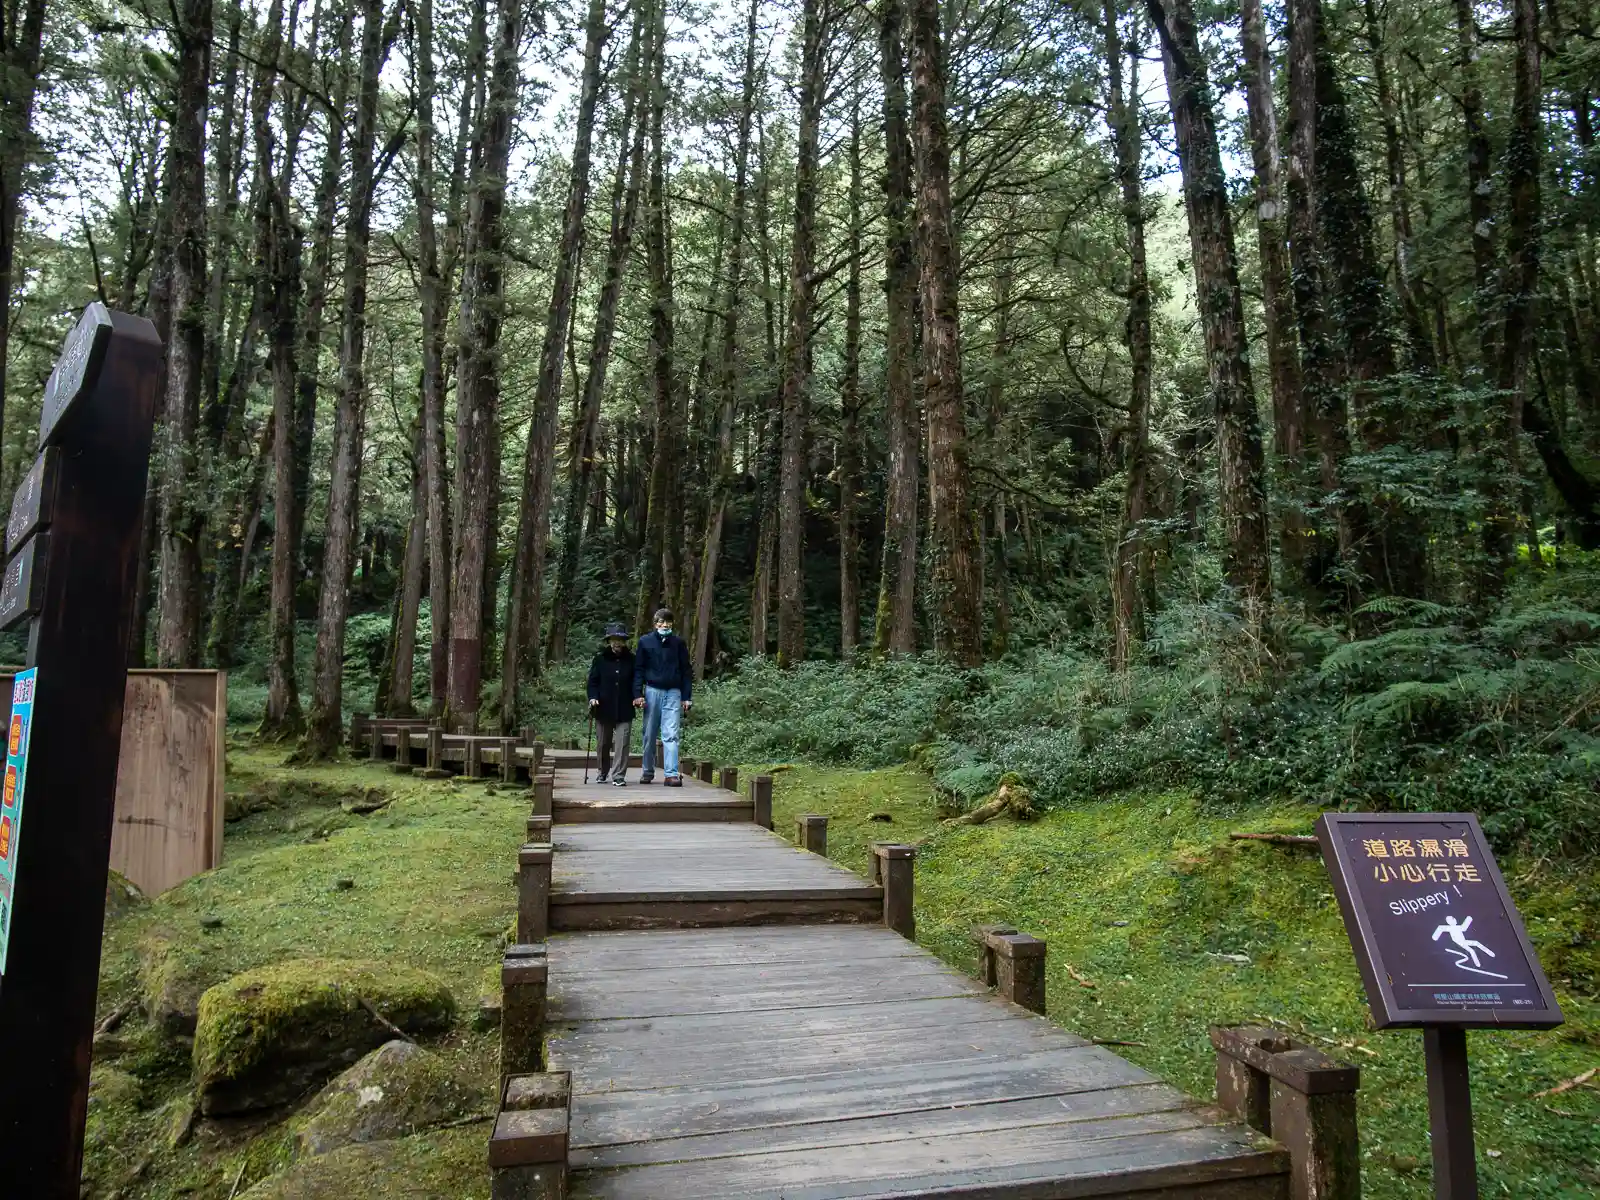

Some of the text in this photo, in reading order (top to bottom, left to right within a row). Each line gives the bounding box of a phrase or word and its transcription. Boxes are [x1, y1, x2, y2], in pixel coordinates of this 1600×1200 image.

[1362, 838, 1470, 858] 道路濕滑
[1373, 862, 1482, 883] 小心行走
[1389, 890, 1450, 915] Slippery
